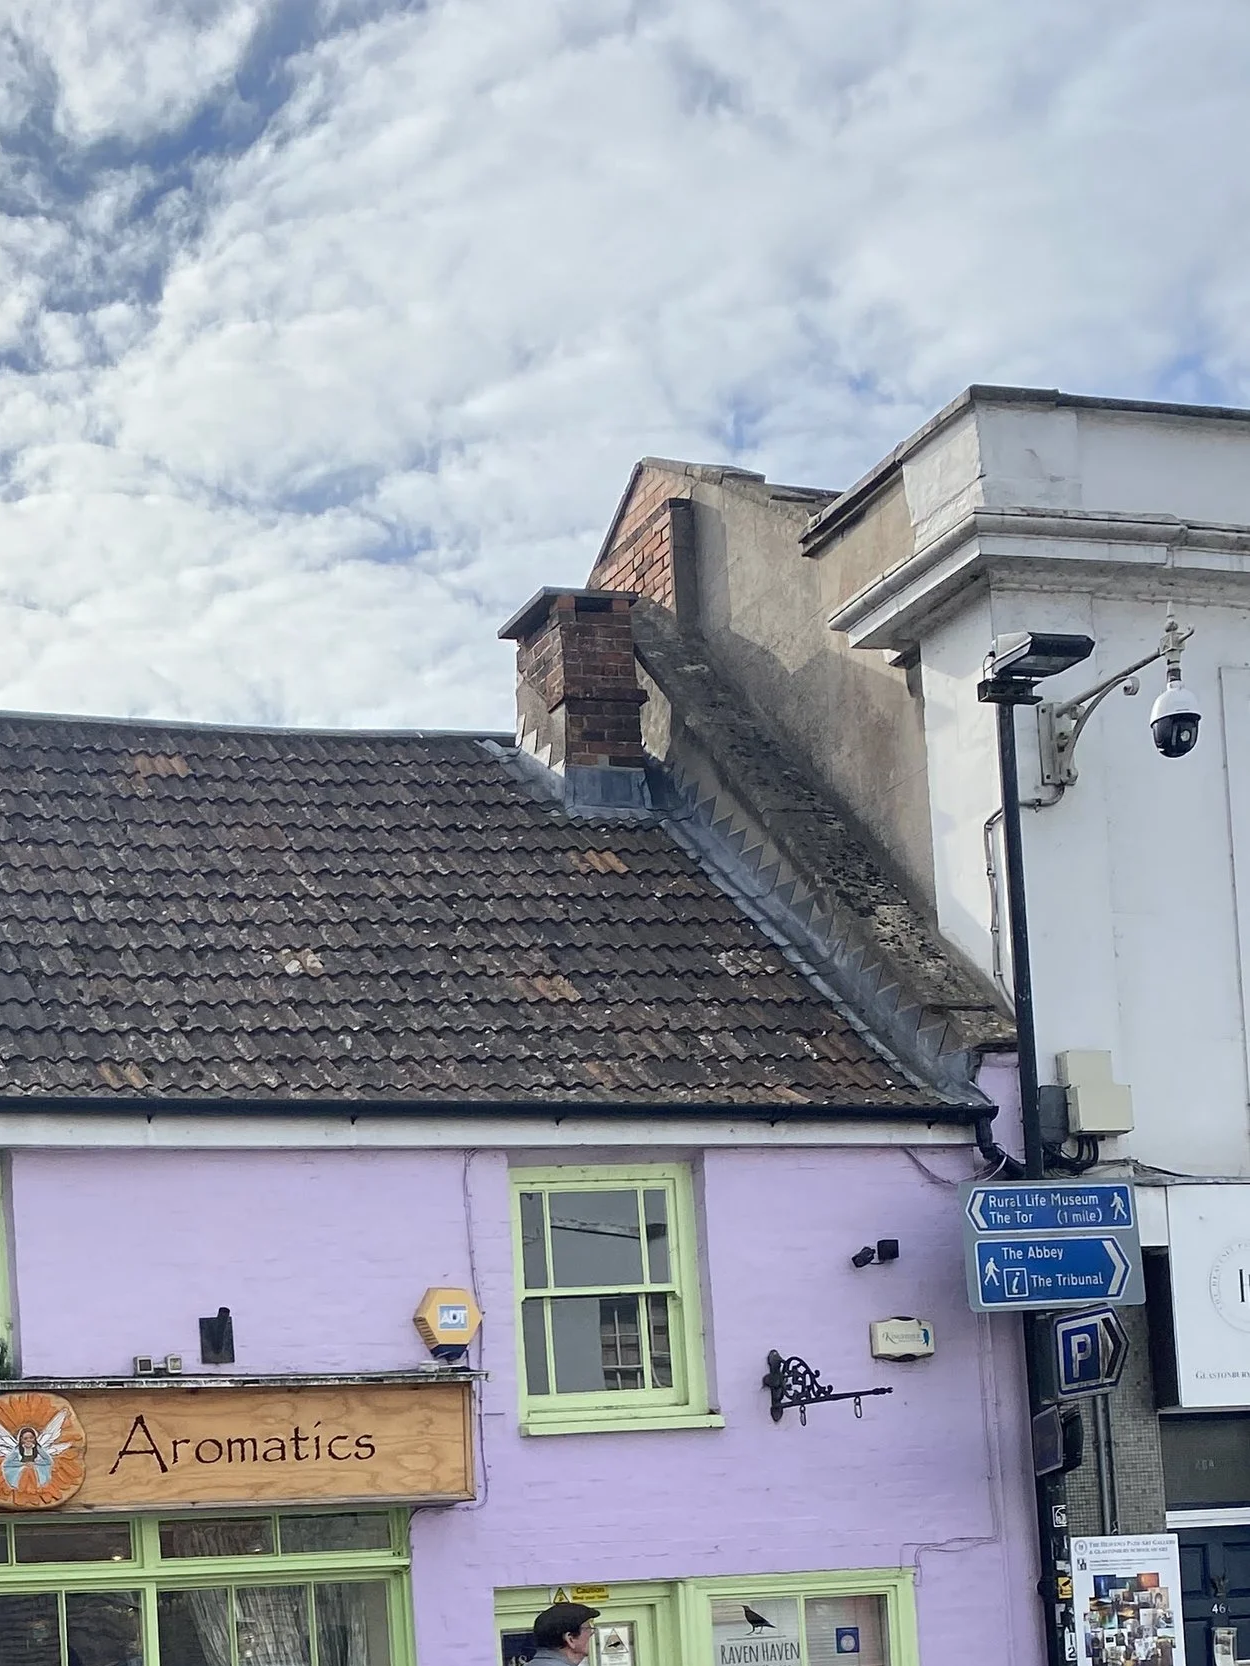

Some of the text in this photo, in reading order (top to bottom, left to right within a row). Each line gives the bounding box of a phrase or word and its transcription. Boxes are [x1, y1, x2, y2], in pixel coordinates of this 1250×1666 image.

[988, 1192, 1099, 1208] Rural Life Museum
[989, 1207, 1103, 1225] The Tor (1 mile)
[1001, 1245, 1064, 1261] The Abbey
[1030, 1271, 1104, 1288] The Tribunal
[440, 1309, 468, 1325] ADT
[1070, 1333, 1092, 1379] P
[108, 1413, 376, 1475] Aromatics
[720, 1641, 800, 1665] RAVEN HAVEN
